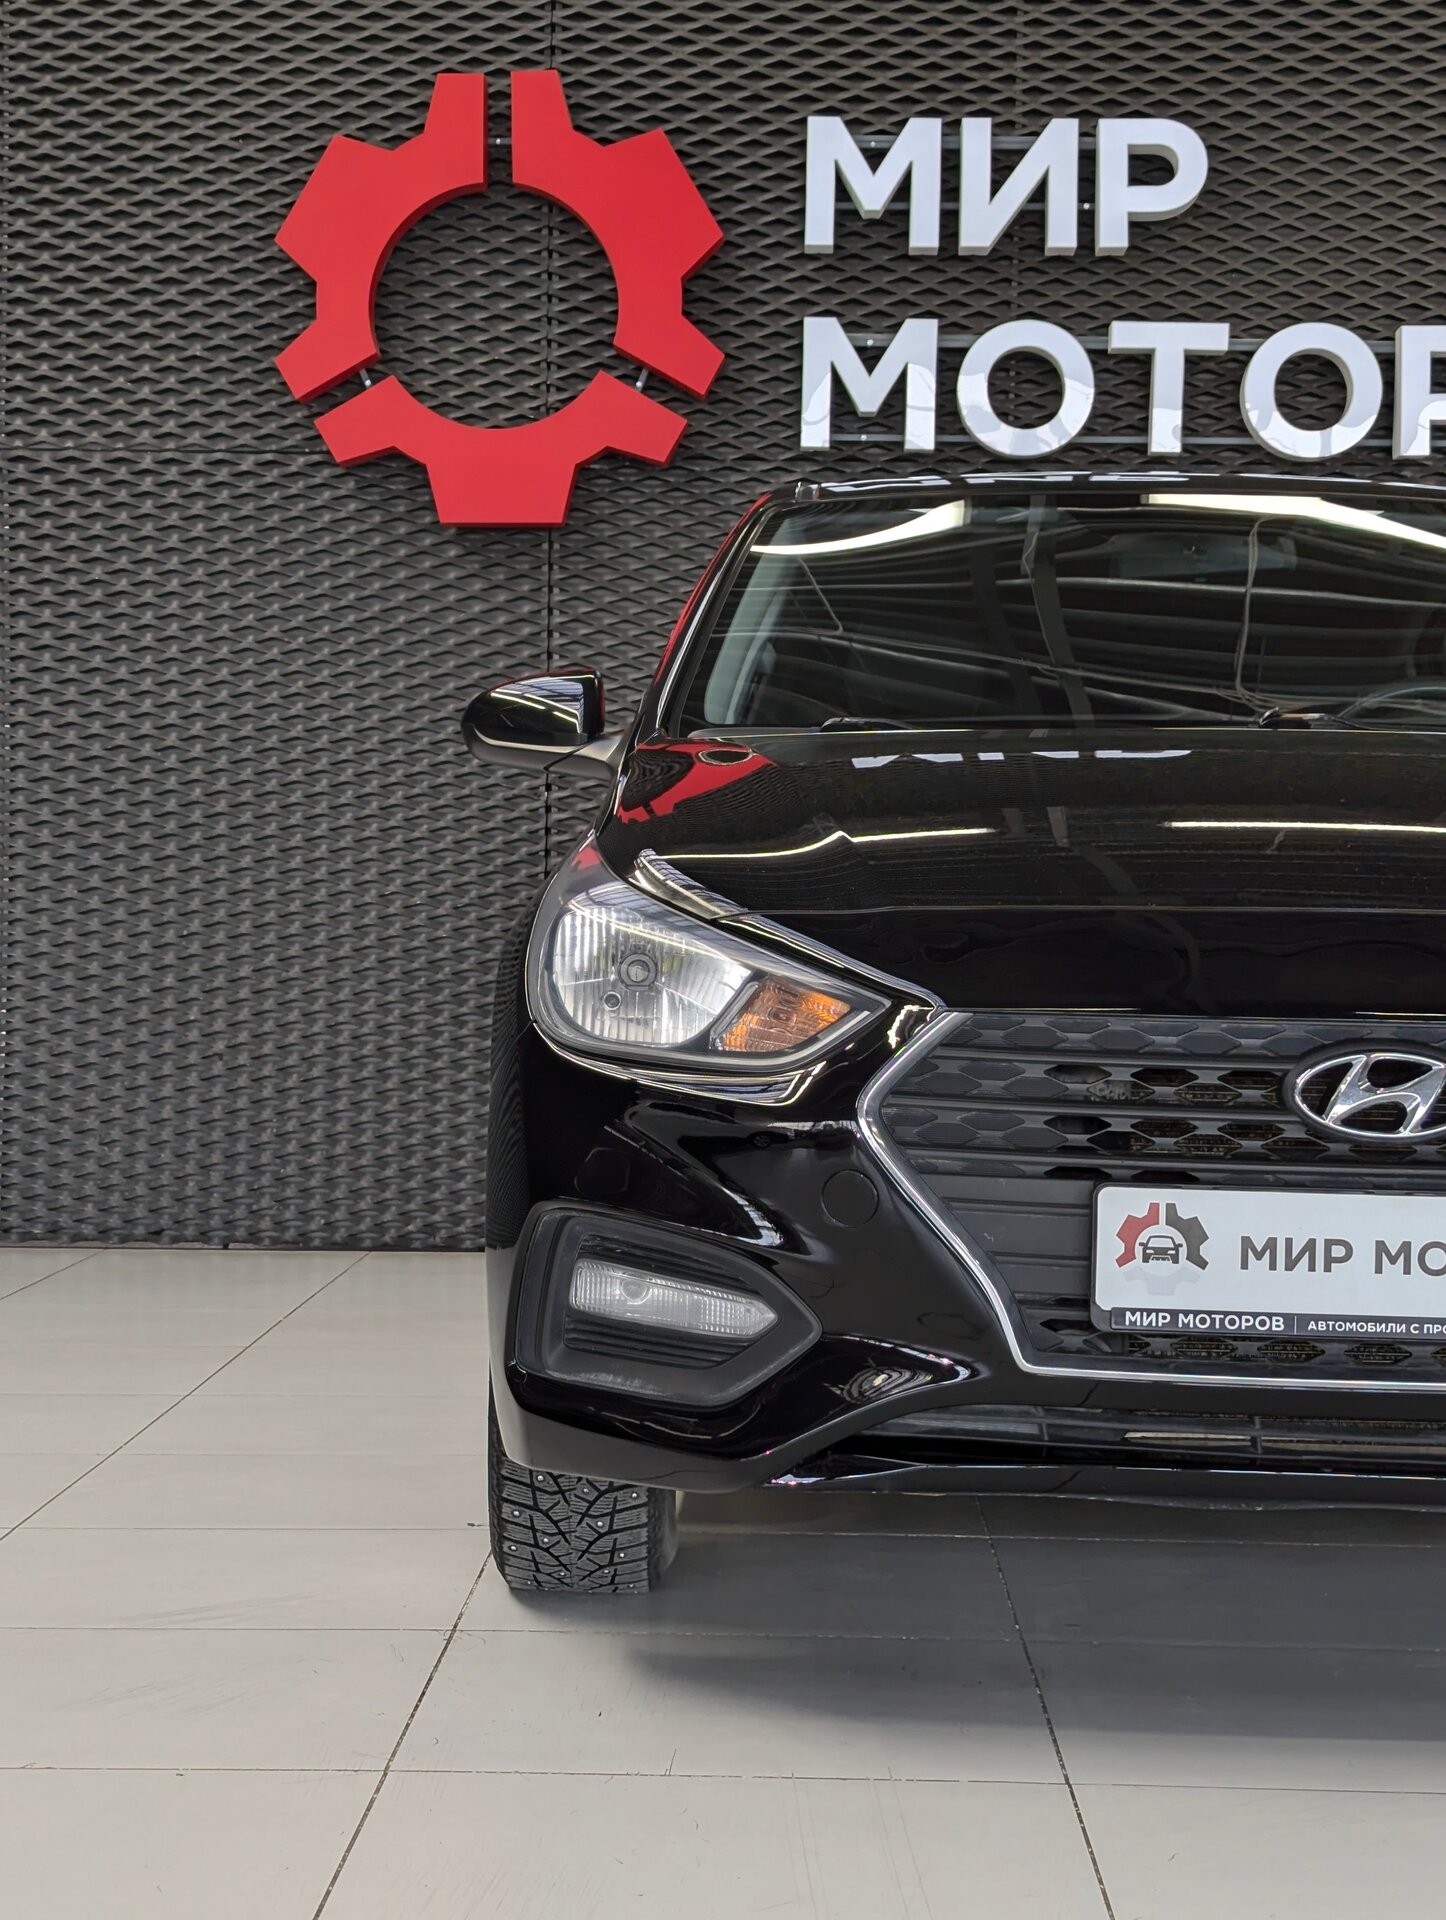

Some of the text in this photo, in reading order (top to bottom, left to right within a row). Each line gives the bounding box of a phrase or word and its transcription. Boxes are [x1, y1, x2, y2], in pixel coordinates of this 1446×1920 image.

[803, 116, 1208, 256] МИР
[1240, 1235, 1446, 1277] МИР МО
[1125, 1311, 1285, 1331] МИР МОТОРОВ
[1307, 1320, 1406, 1333] АВТОМОБИЛИ
[1410, 1323, 1420, 1334] С
